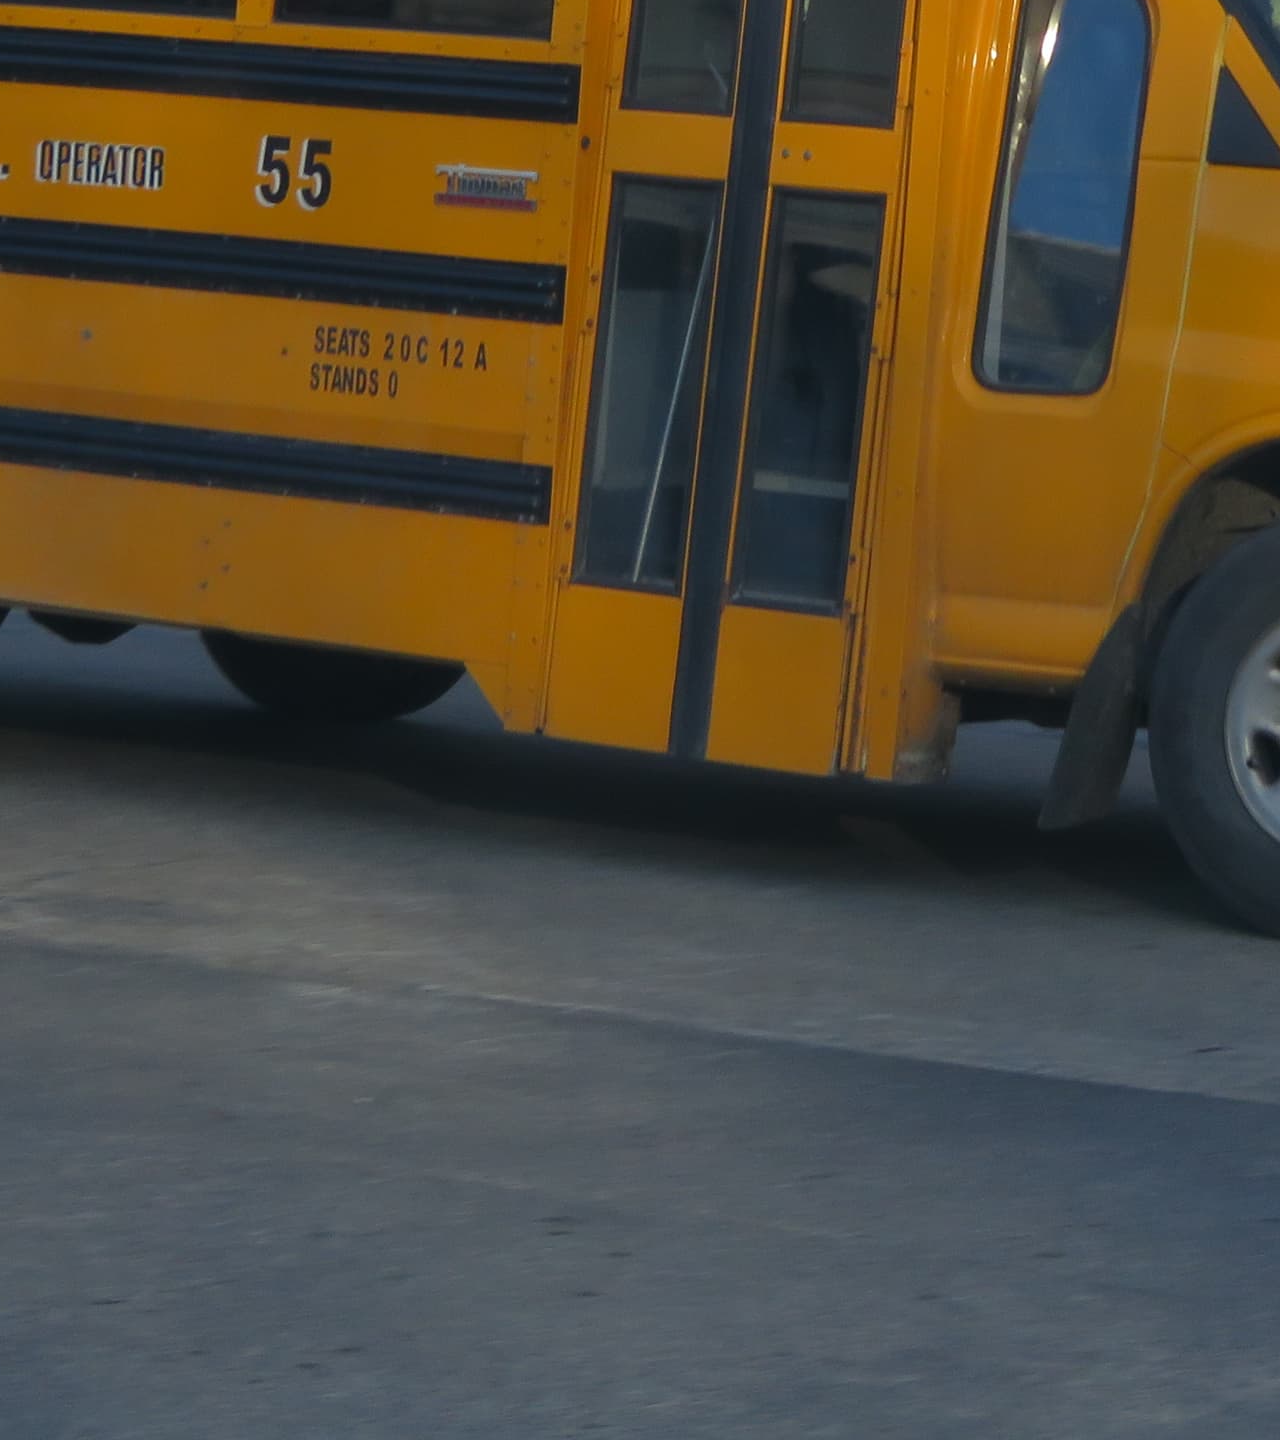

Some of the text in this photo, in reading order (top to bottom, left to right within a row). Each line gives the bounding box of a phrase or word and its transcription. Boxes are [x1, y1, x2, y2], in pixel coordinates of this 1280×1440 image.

[34, 140, 165, 191] OPERATOR
[255, 134, 333, 210] 55
[314, 325, 370, 358] SEATS
[439, 338, 465, 369] 12
[474, 342, 488, 372] A
[310, 363, 399, 399] STANDS 0
